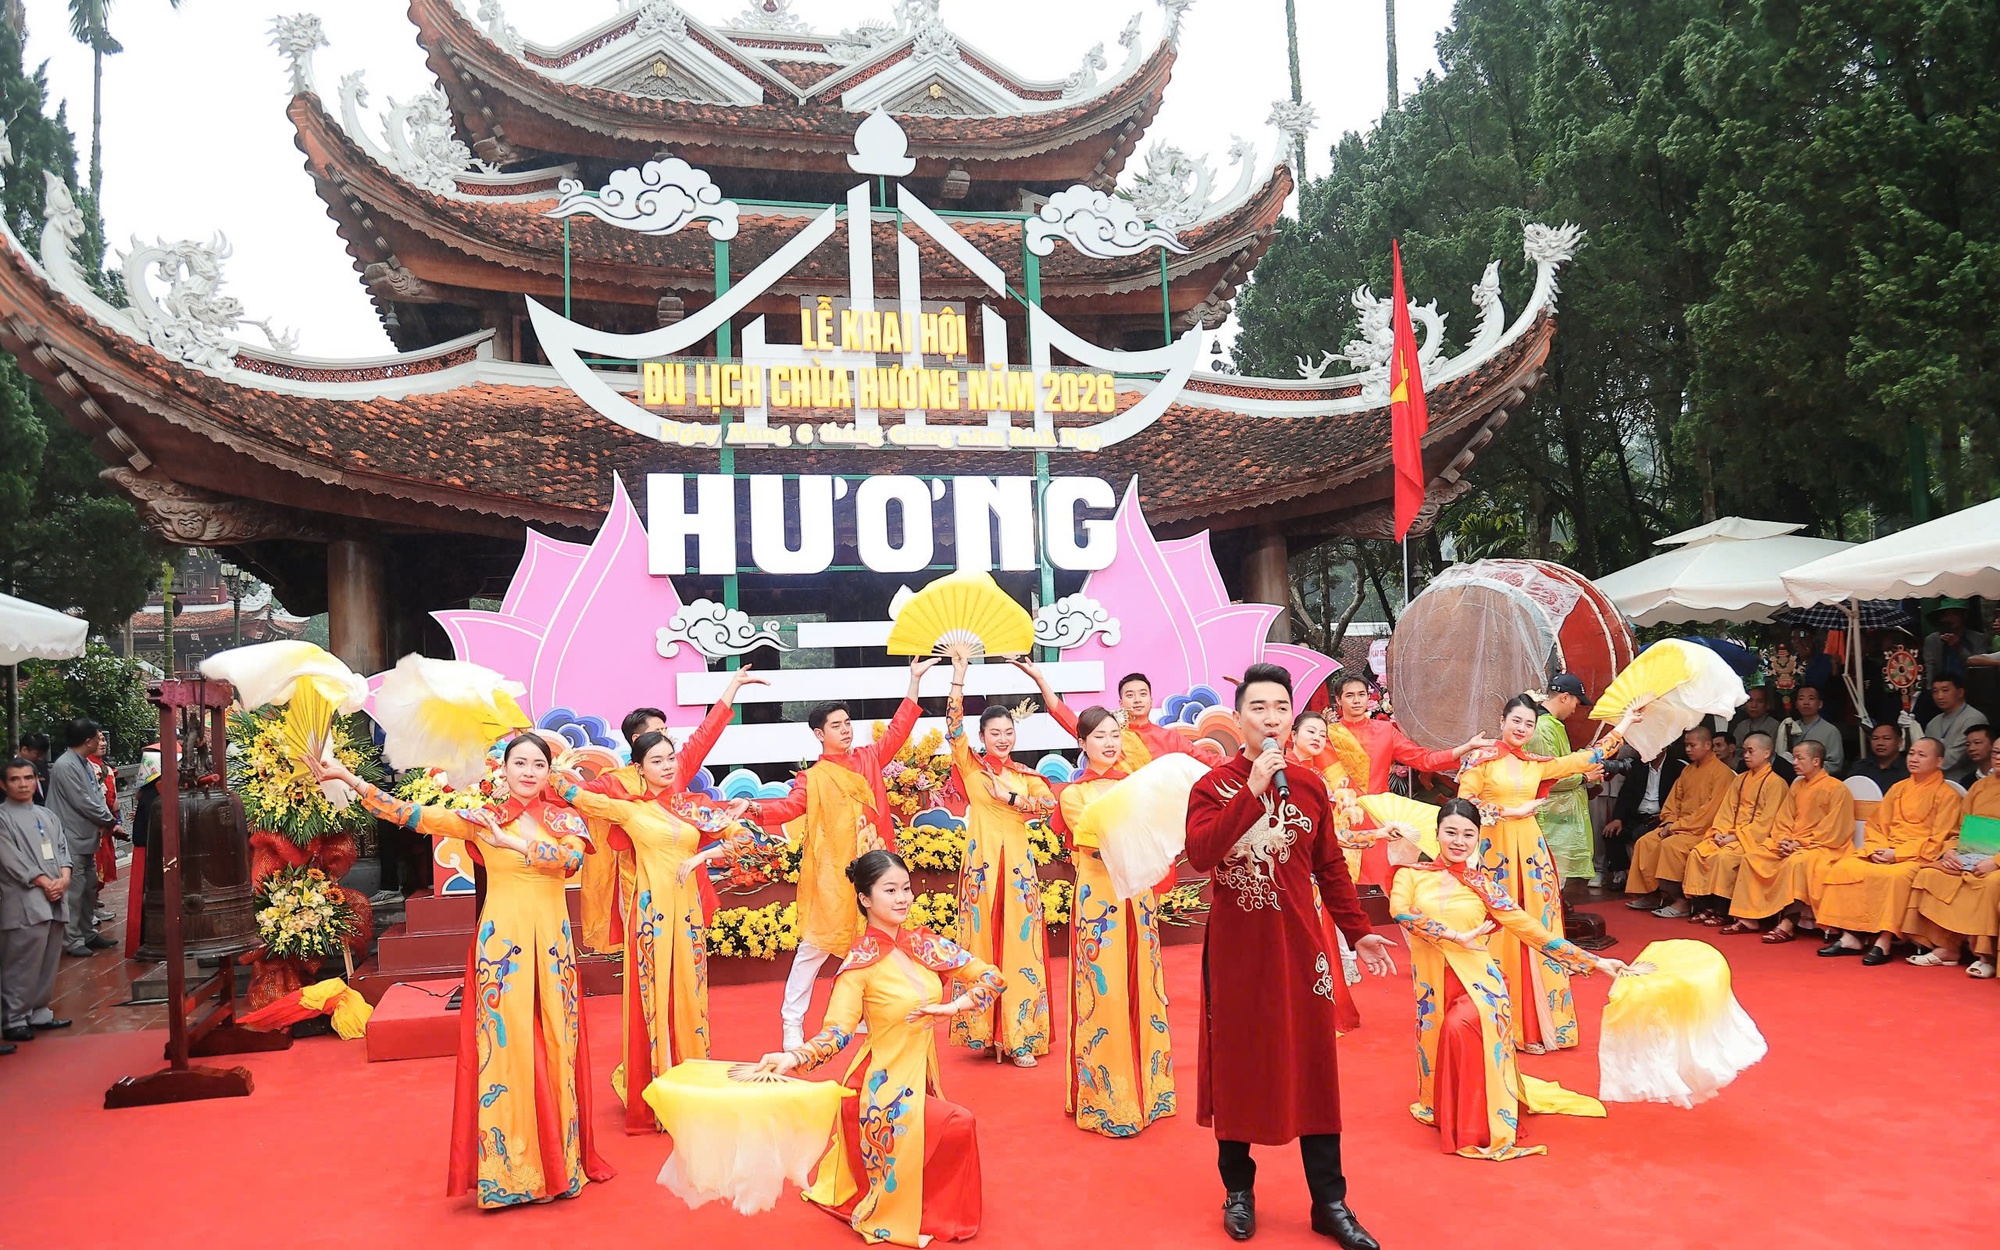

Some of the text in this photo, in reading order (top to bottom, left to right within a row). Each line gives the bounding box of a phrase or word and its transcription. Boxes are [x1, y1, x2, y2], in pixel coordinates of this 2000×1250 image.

[801, 296, 967, 361] LỄ KHAI HỘI
[643, 357, 1116, 414] DU LỊCH CHÙA HƯƠNG NĂM 2026
[660, 421, 718, 446] Ngày
[728, 424, 791, 446] Mùng
[797, 425, 812, 442] 6
[819, 423, 883, 446] tháng
[889, 426, 952, 448] Giêng
[958, 428, 1003, 445] năm
[647, 473, 1118, 576] HƯƠNG
